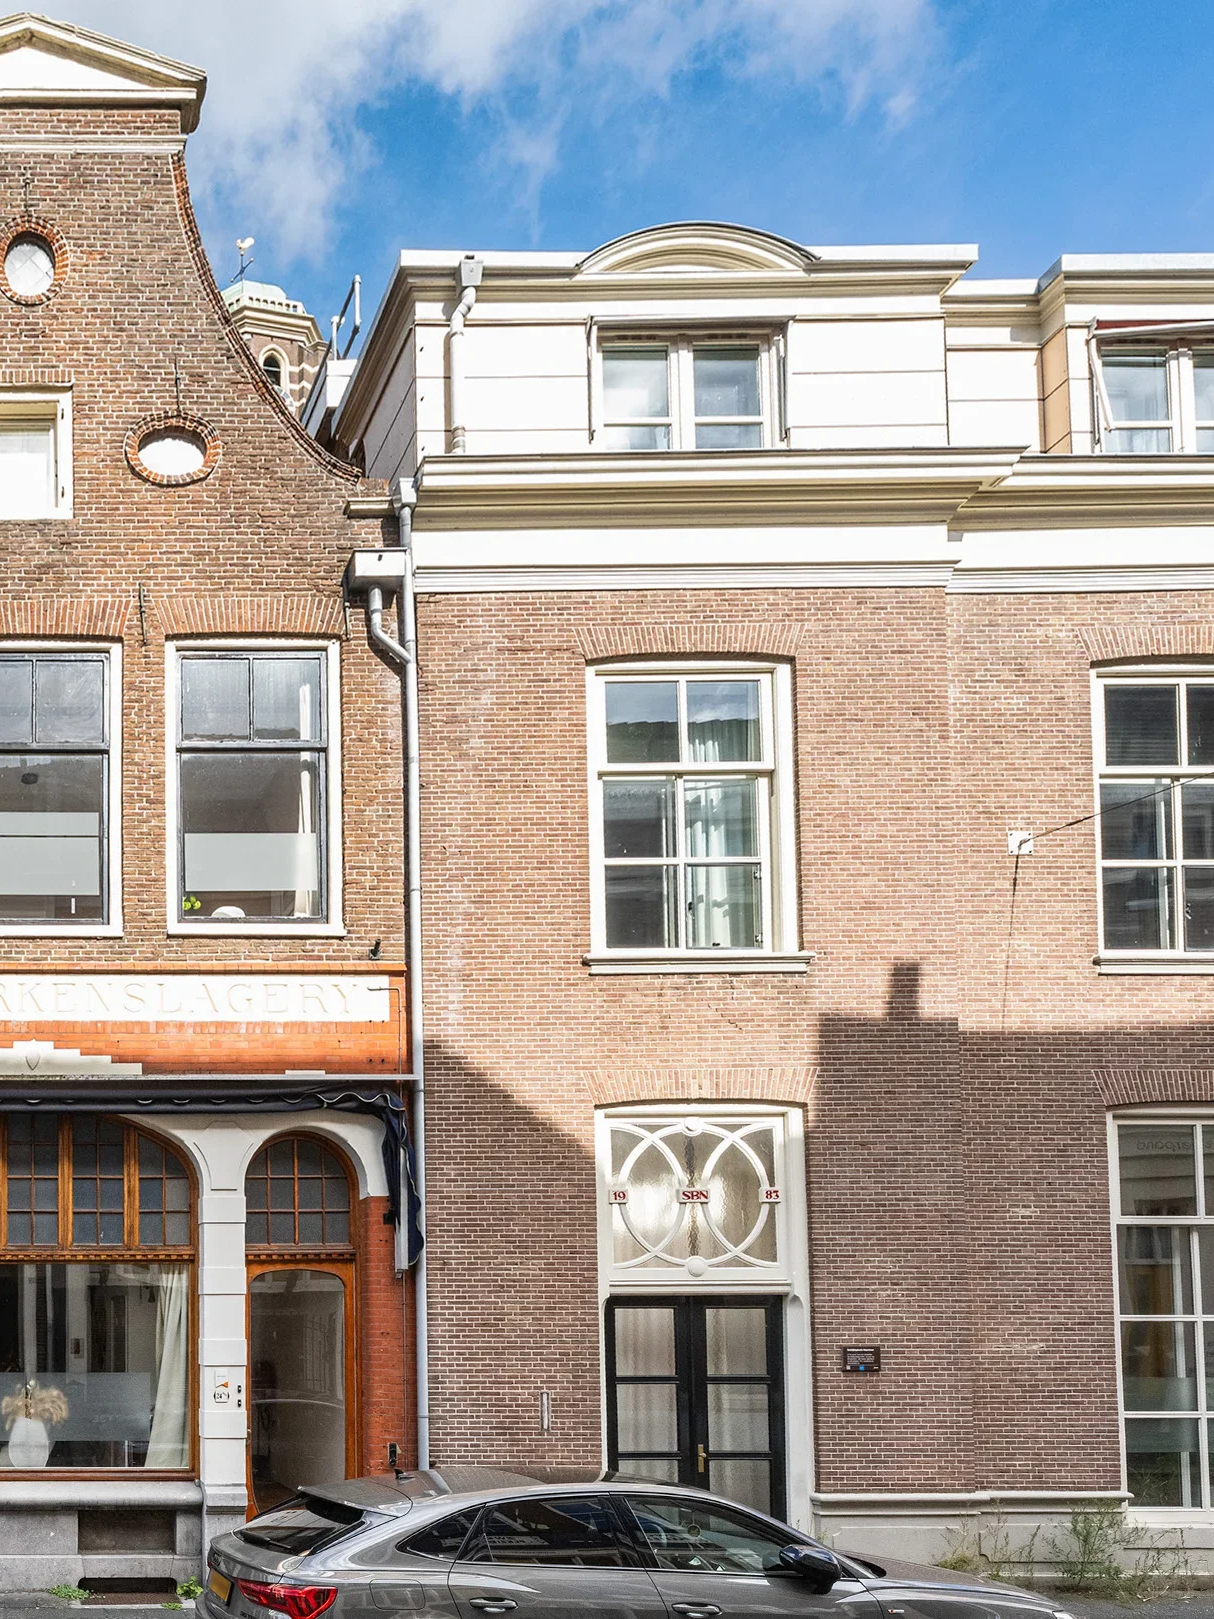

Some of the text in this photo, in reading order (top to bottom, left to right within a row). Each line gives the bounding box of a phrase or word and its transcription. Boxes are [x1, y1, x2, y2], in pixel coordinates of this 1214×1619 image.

[613, 1190, 780, 1201] 19 SBN 83
